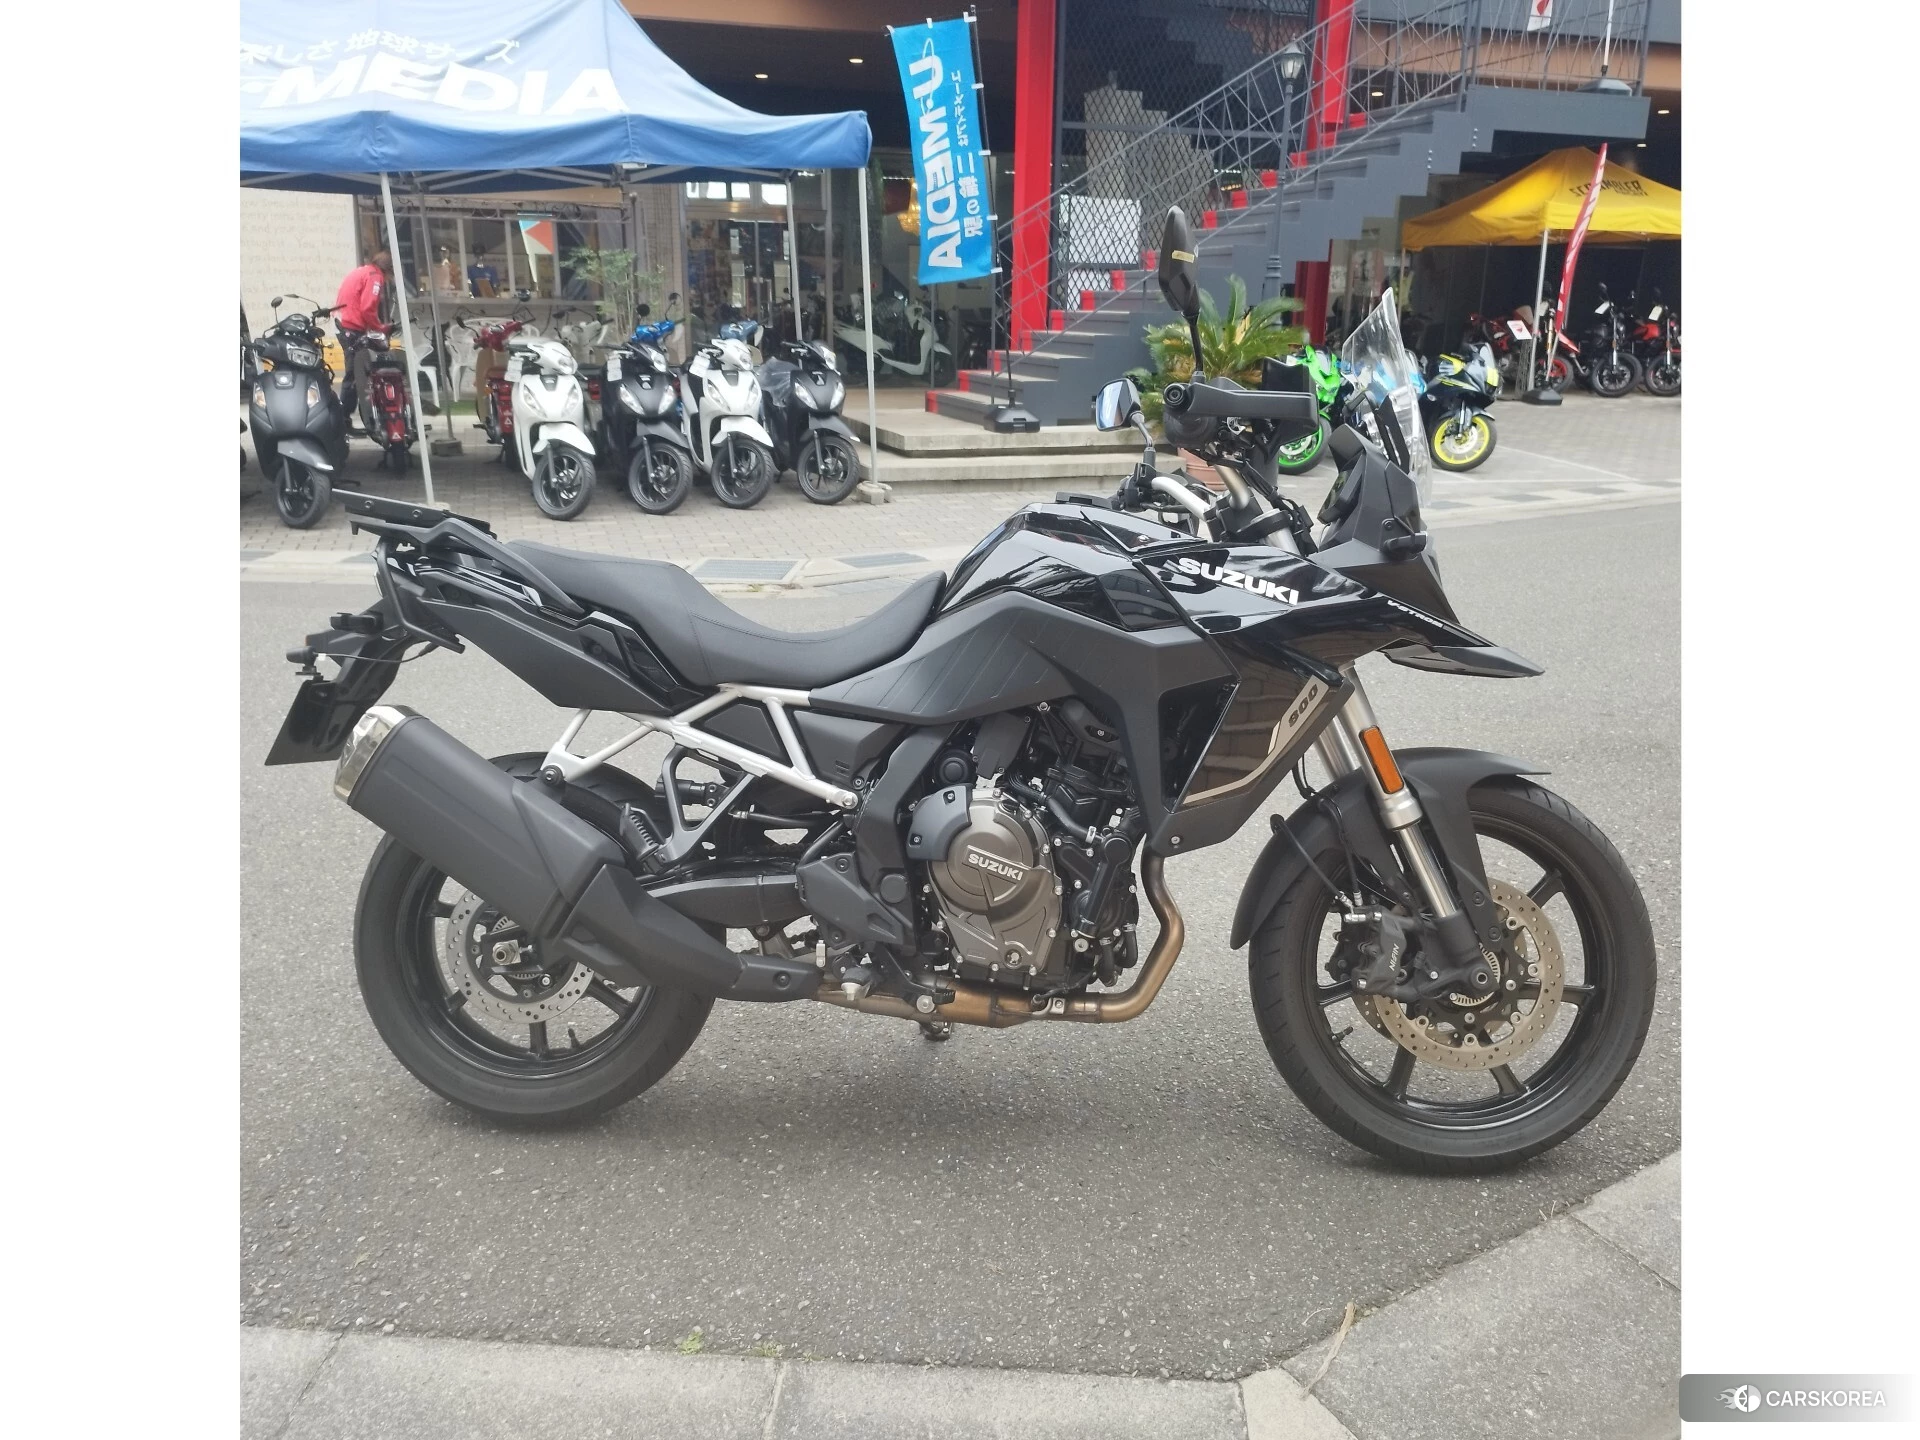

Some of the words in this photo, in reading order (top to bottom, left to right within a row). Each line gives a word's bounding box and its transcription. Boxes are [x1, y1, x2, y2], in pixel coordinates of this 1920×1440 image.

[1179, 557, 1299, 605] SUZUKI
[1288, 683, 1319, 728] 800
[967, 852, 1024, 881] SUZUKI
